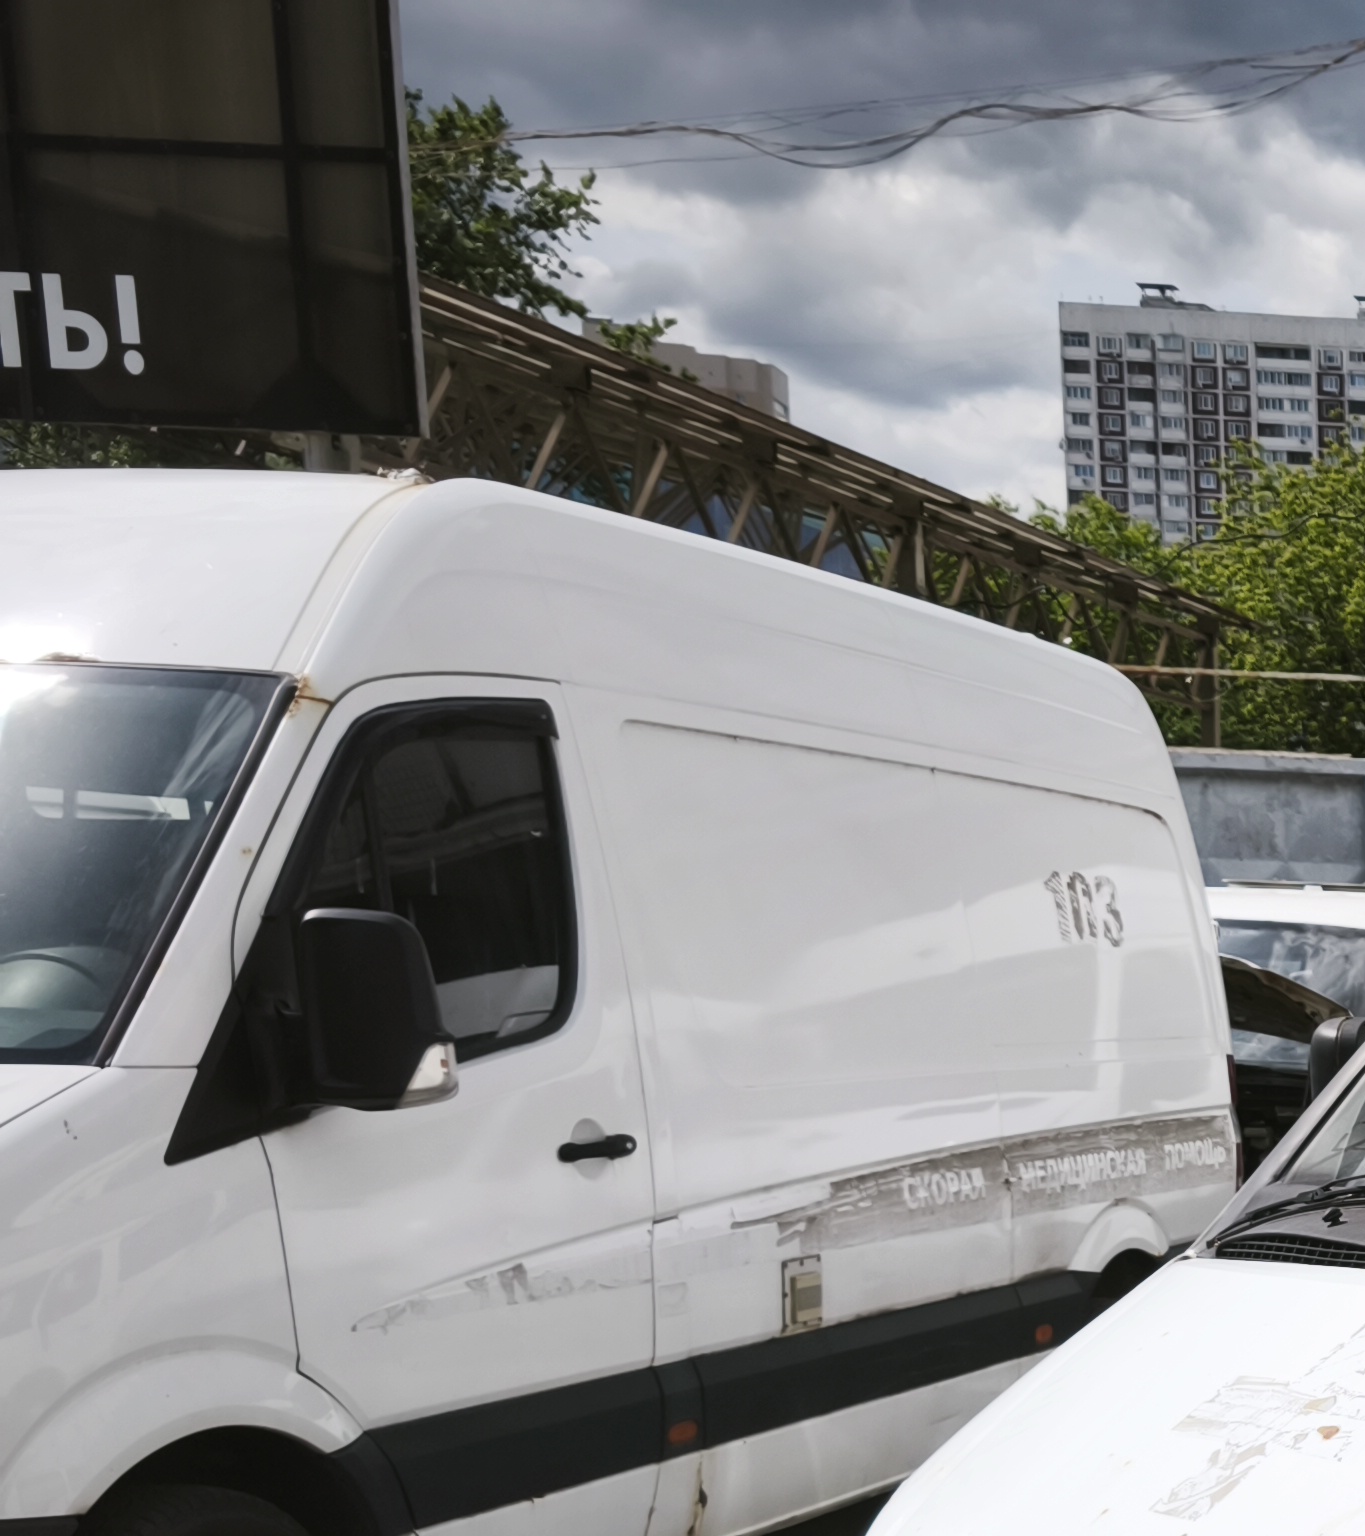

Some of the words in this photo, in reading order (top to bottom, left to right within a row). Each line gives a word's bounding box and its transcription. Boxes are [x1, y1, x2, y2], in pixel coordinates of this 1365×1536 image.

[1044, 870, 1124, 947] 103
[1018, 1148, 1147, 1194] МЕДИЦИНСКАЯ
[1162, 1137, 1226, 1171] ПОМОЩЬ
